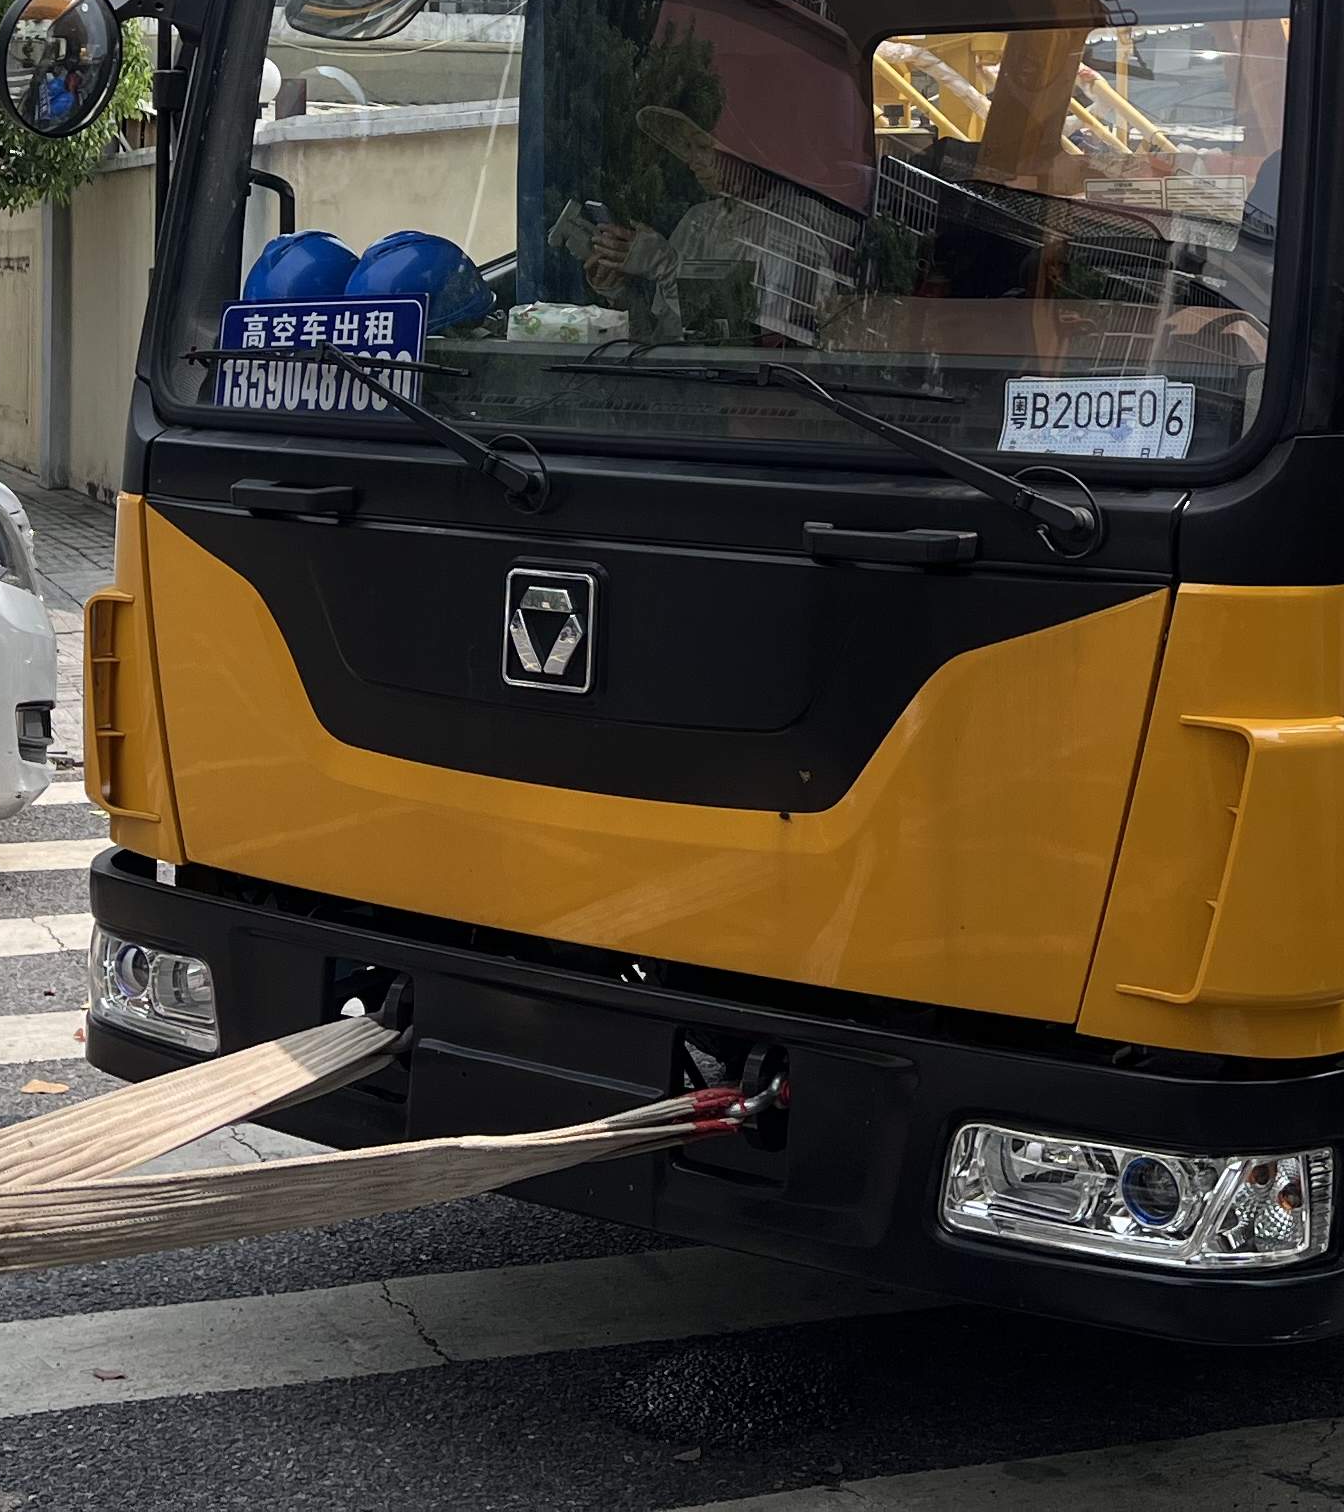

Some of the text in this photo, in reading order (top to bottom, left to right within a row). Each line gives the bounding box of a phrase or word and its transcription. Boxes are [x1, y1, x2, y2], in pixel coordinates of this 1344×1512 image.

[242, 310, 395, 349] 高空车出租
